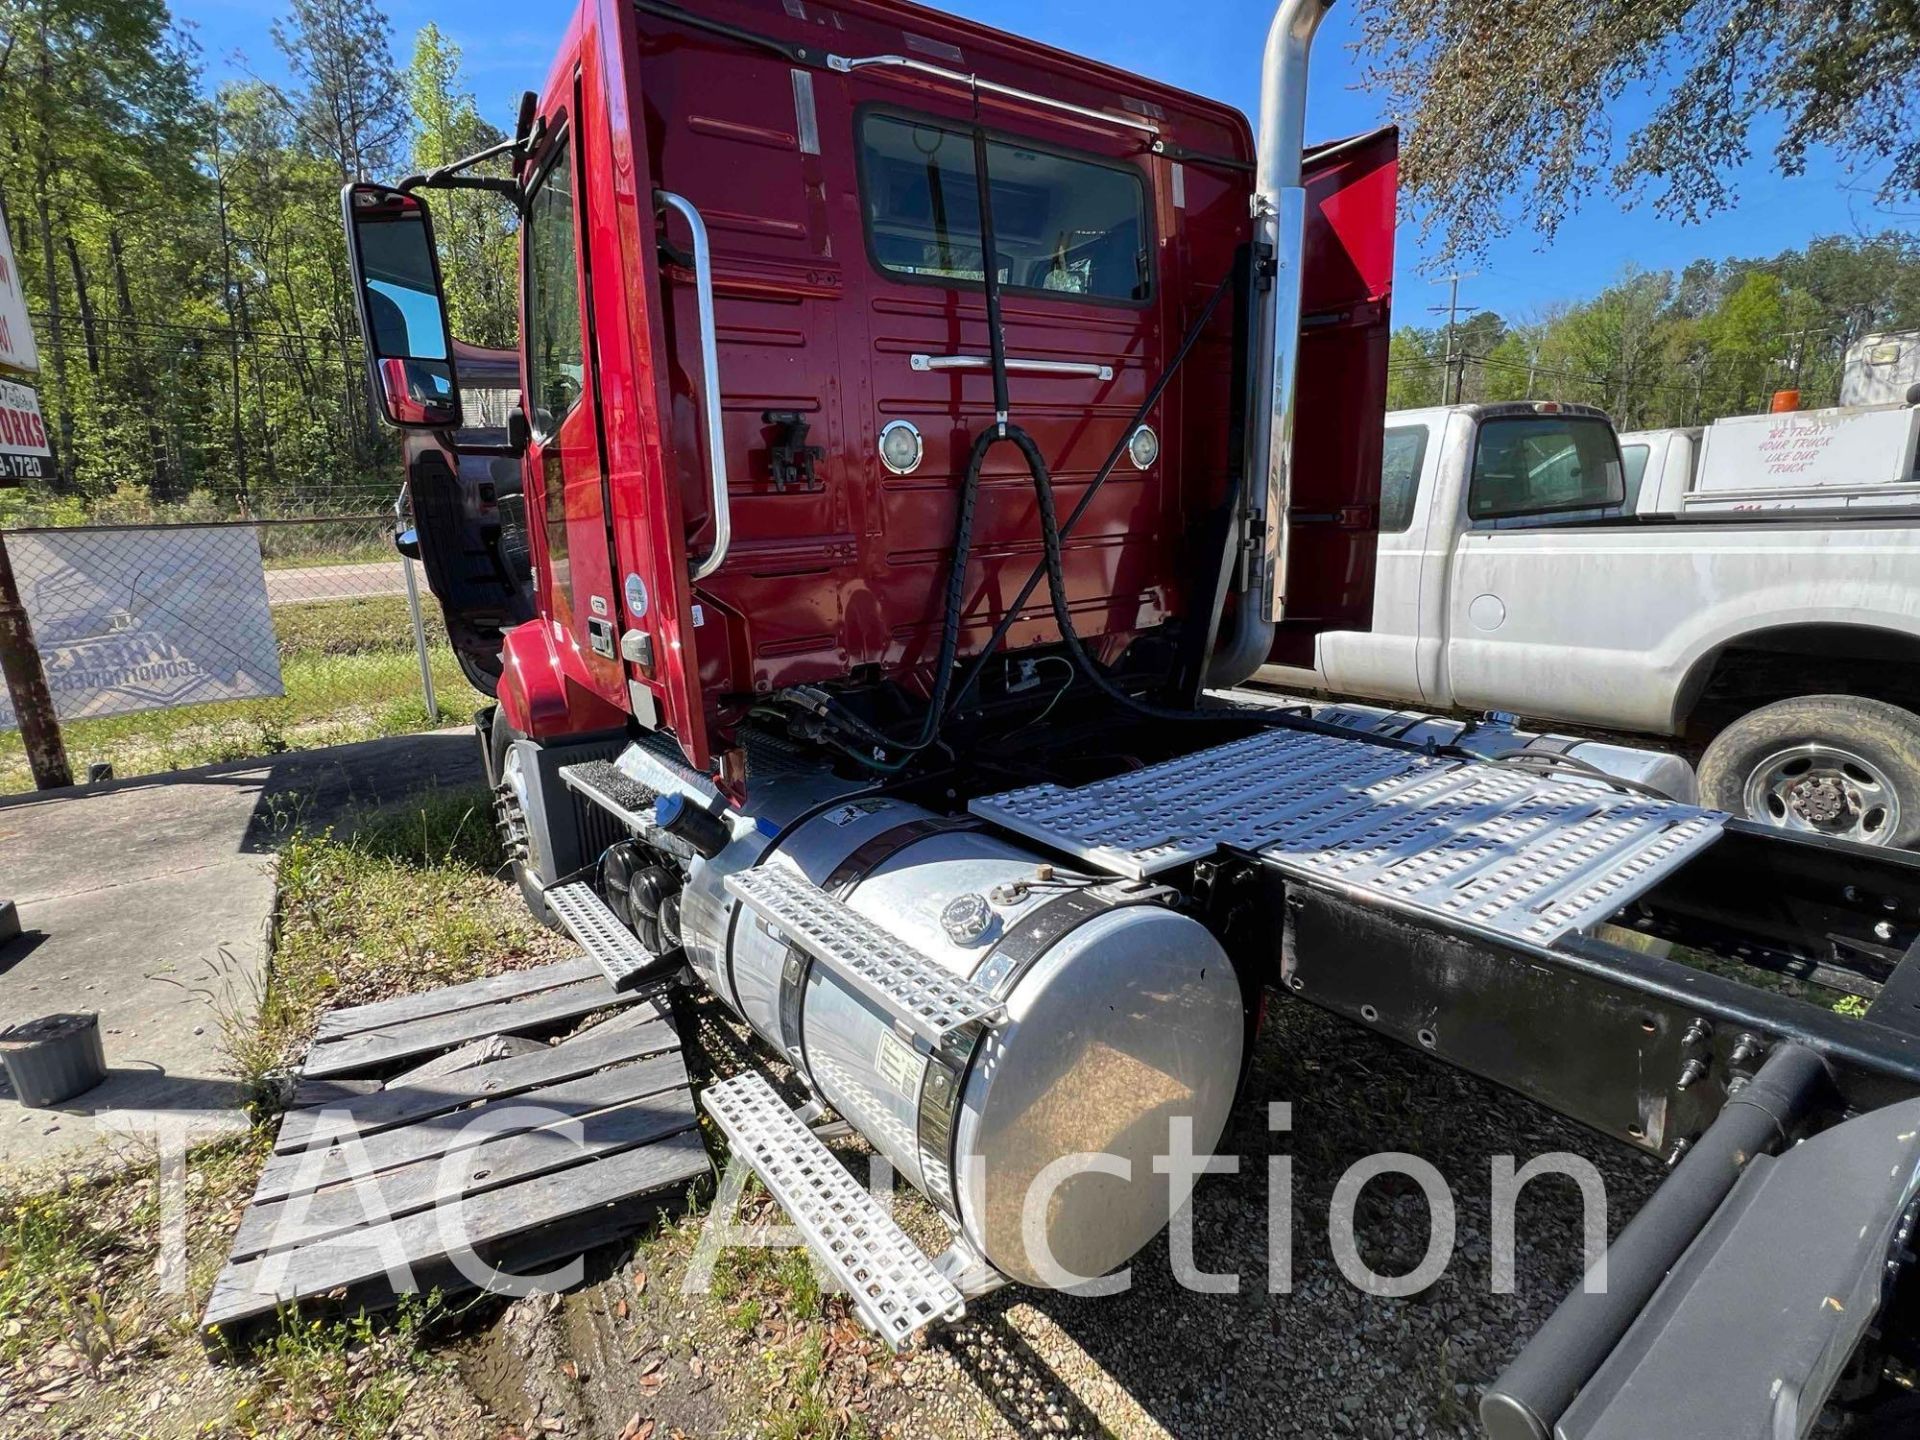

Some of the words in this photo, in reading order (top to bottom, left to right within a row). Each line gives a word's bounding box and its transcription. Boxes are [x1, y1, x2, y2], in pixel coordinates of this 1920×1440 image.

[0, 406, 46, 449] ORKS
[1791, 436, 1834, 449] TRUCK
[1764, 451, 1792, 463] LIKE
[1792, 449, 1820, 461] OUR
